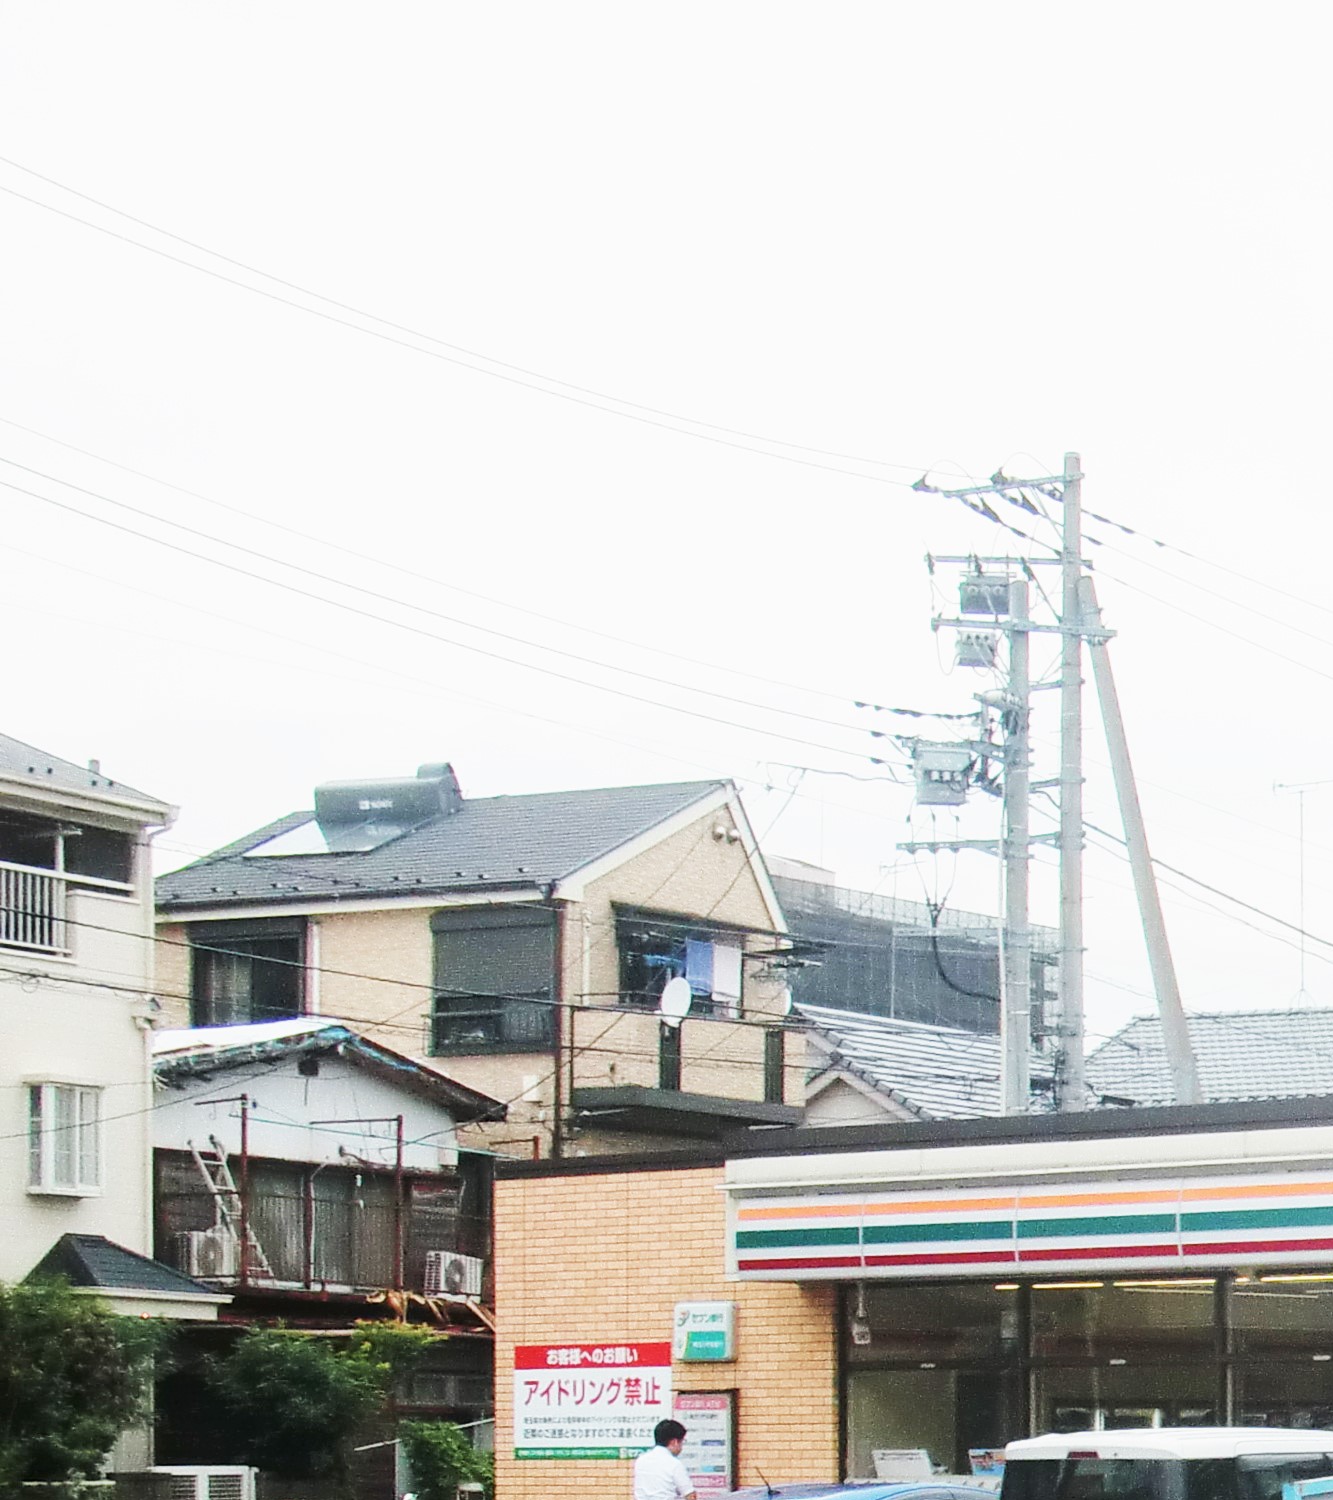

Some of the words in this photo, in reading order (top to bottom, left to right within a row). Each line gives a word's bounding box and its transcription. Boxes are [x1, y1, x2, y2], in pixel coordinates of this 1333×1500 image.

[523, 1376, 662, 1406] アイドリング禁止
